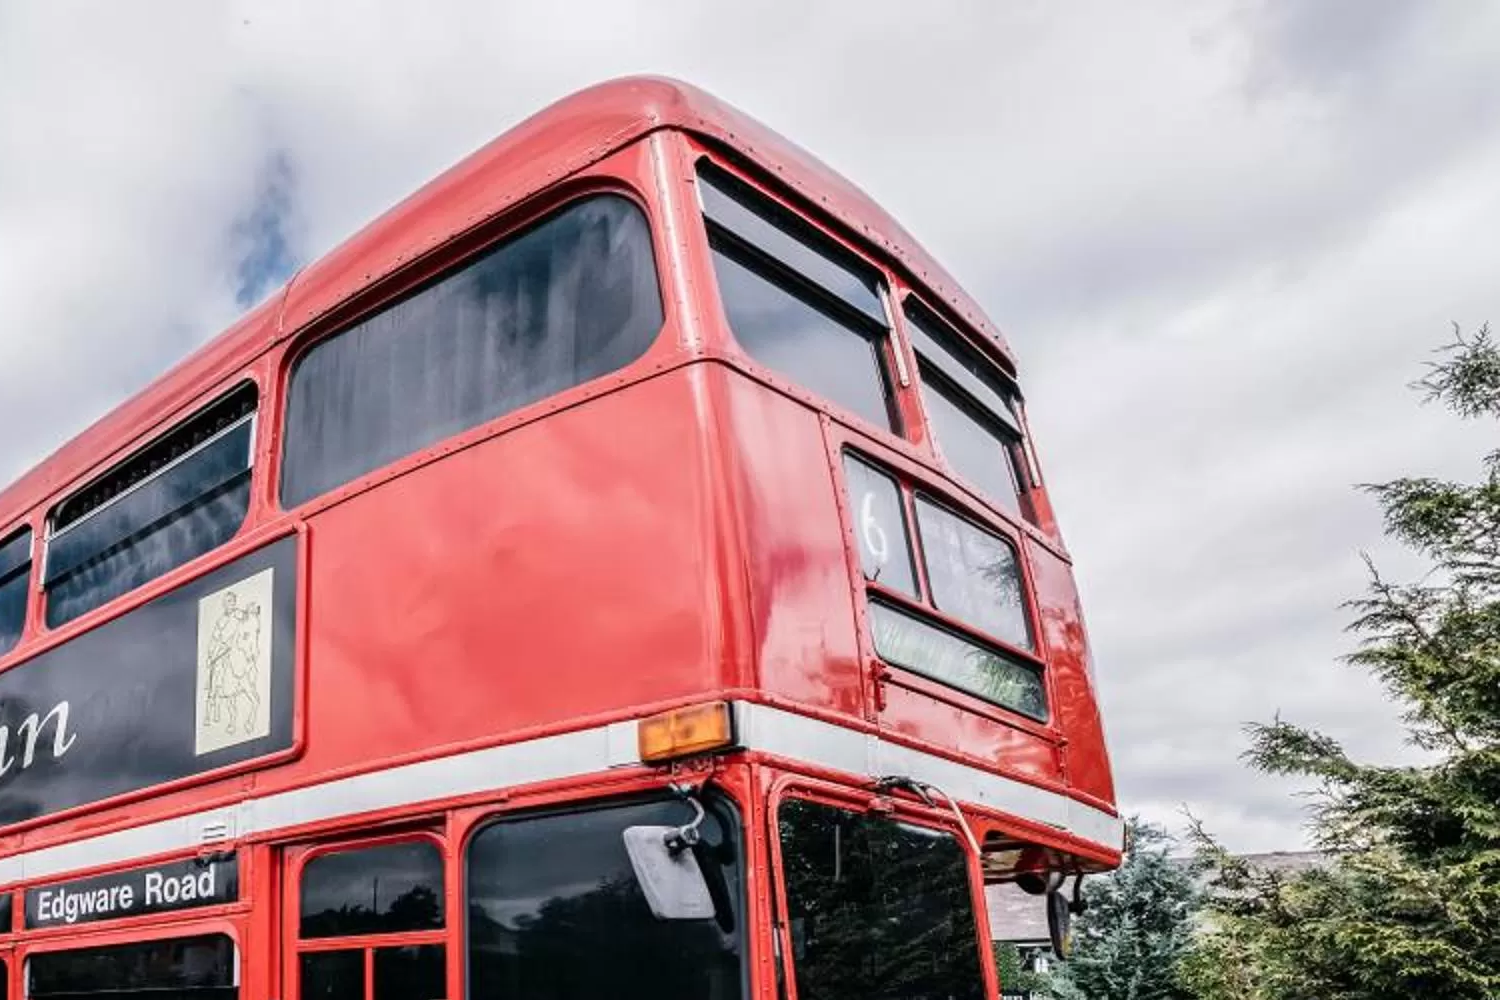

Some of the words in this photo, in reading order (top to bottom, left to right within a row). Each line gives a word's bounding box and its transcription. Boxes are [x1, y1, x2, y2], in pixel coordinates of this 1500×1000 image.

[862, 491, 887, 563] 6
[36, 884, 133, 924] Edgware
[144, 864, 216, 906] Road
